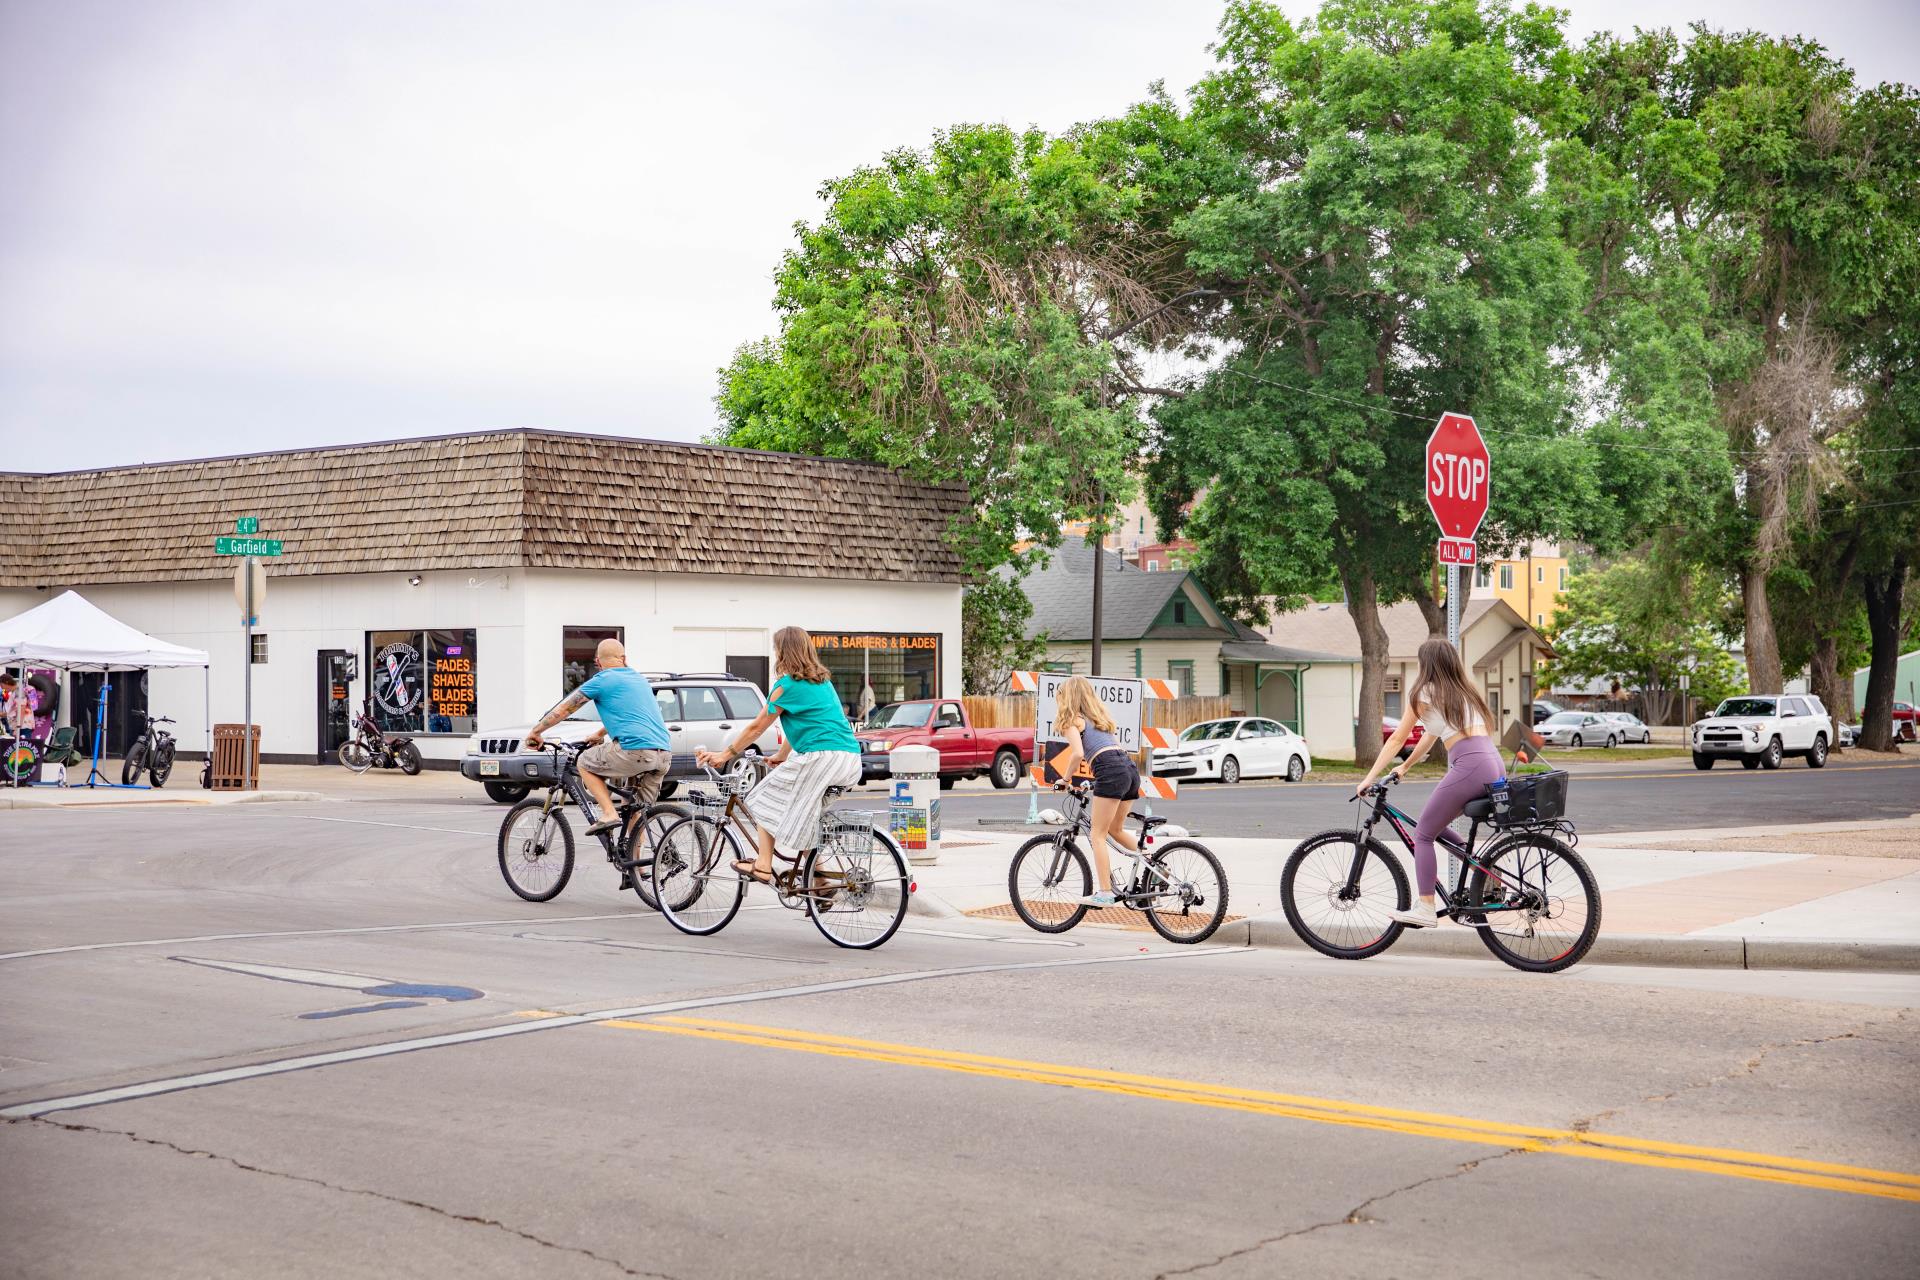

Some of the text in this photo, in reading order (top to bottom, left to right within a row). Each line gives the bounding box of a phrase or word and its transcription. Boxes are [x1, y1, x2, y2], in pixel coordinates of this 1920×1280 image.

[1431, 452, 1485, 501] STOP
[231, 540, 267, 554] Garfield
[1443, 545, 1456, 559] ALL
[842, 636, 888, 649] BARBERS
[890, 638, 898, 649] &
[900, 637, 936, 649] BLADES
[436, 659, 470, 672] FADES
[433, 674, 474, 687] SHAVES
[432, 688, 474, 702] BLADES
[440, 703, 467, 716] BEER
